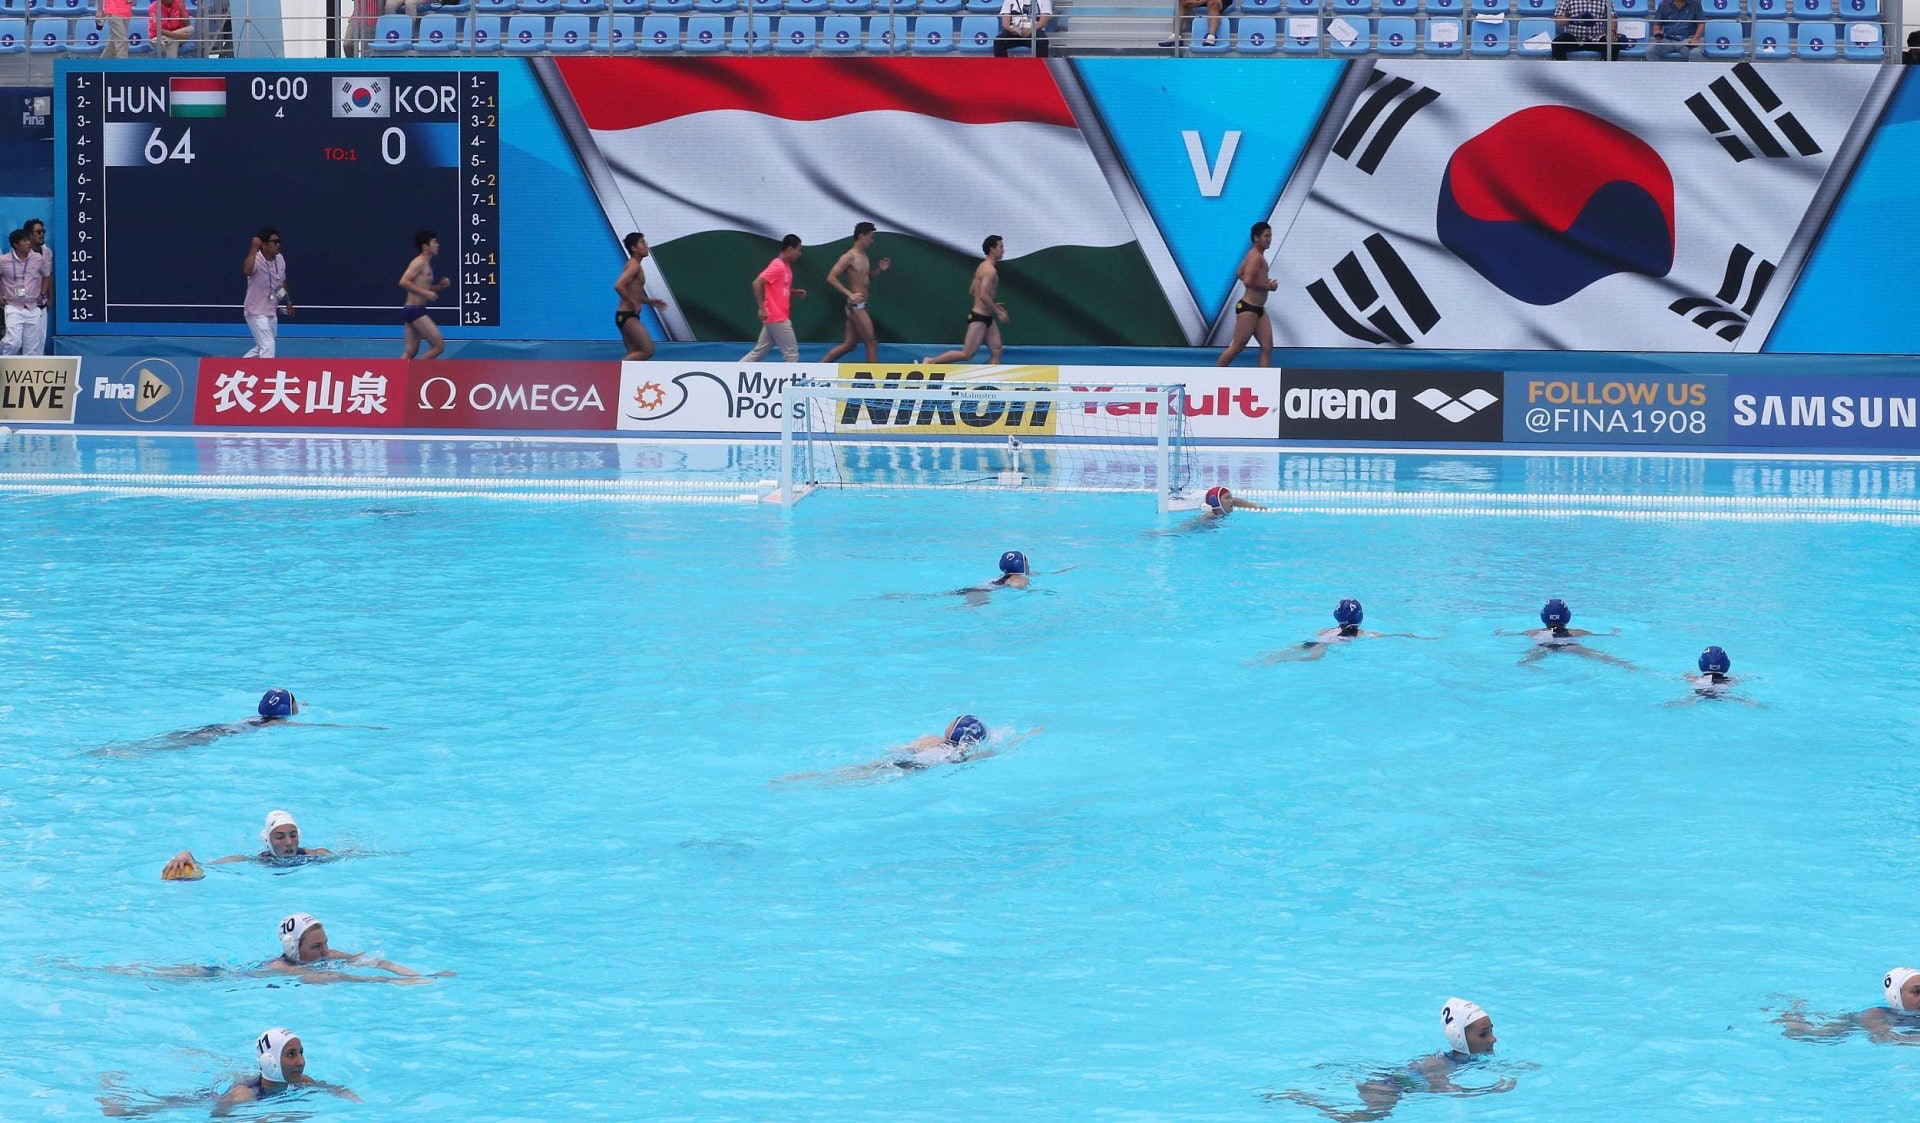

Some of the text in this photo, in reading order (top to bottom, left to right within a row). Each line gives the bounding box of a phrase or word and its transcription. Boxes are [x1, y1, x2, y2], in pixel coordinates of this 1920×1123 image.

[108, 86, 164, 113] HUN
[252, 77, 307, 100] 0:00
[396, 86, 456, 113] KOR
[275, 107, 284, 118] 4
[144, 127, 196, 165] 64
[324, 147, 357, 160] TO:1
[382, 127, 405, 165] 0
[1182, 130, 1241, 196] V
[5, 370, 67, 384] WATCH
[93, 377, 163, 399] Fina tv
[2, 386, 63, 408] LIVE
[212, 370, 388, 415] 农夫山泉
[468, 383, 605, 411] OMEGA
[1284, 388, 1396, 420] arena
[1528, 381, 1706, 406] FOLLOW US
[736, 396, 806, 419] Poos
[1525, 408, 1706, 434] @FINA1908
[281, 918, 295, 934] 10
[1442, 1007, 1453, 1025] 2
[256, 1034, 271, 1054] 11
